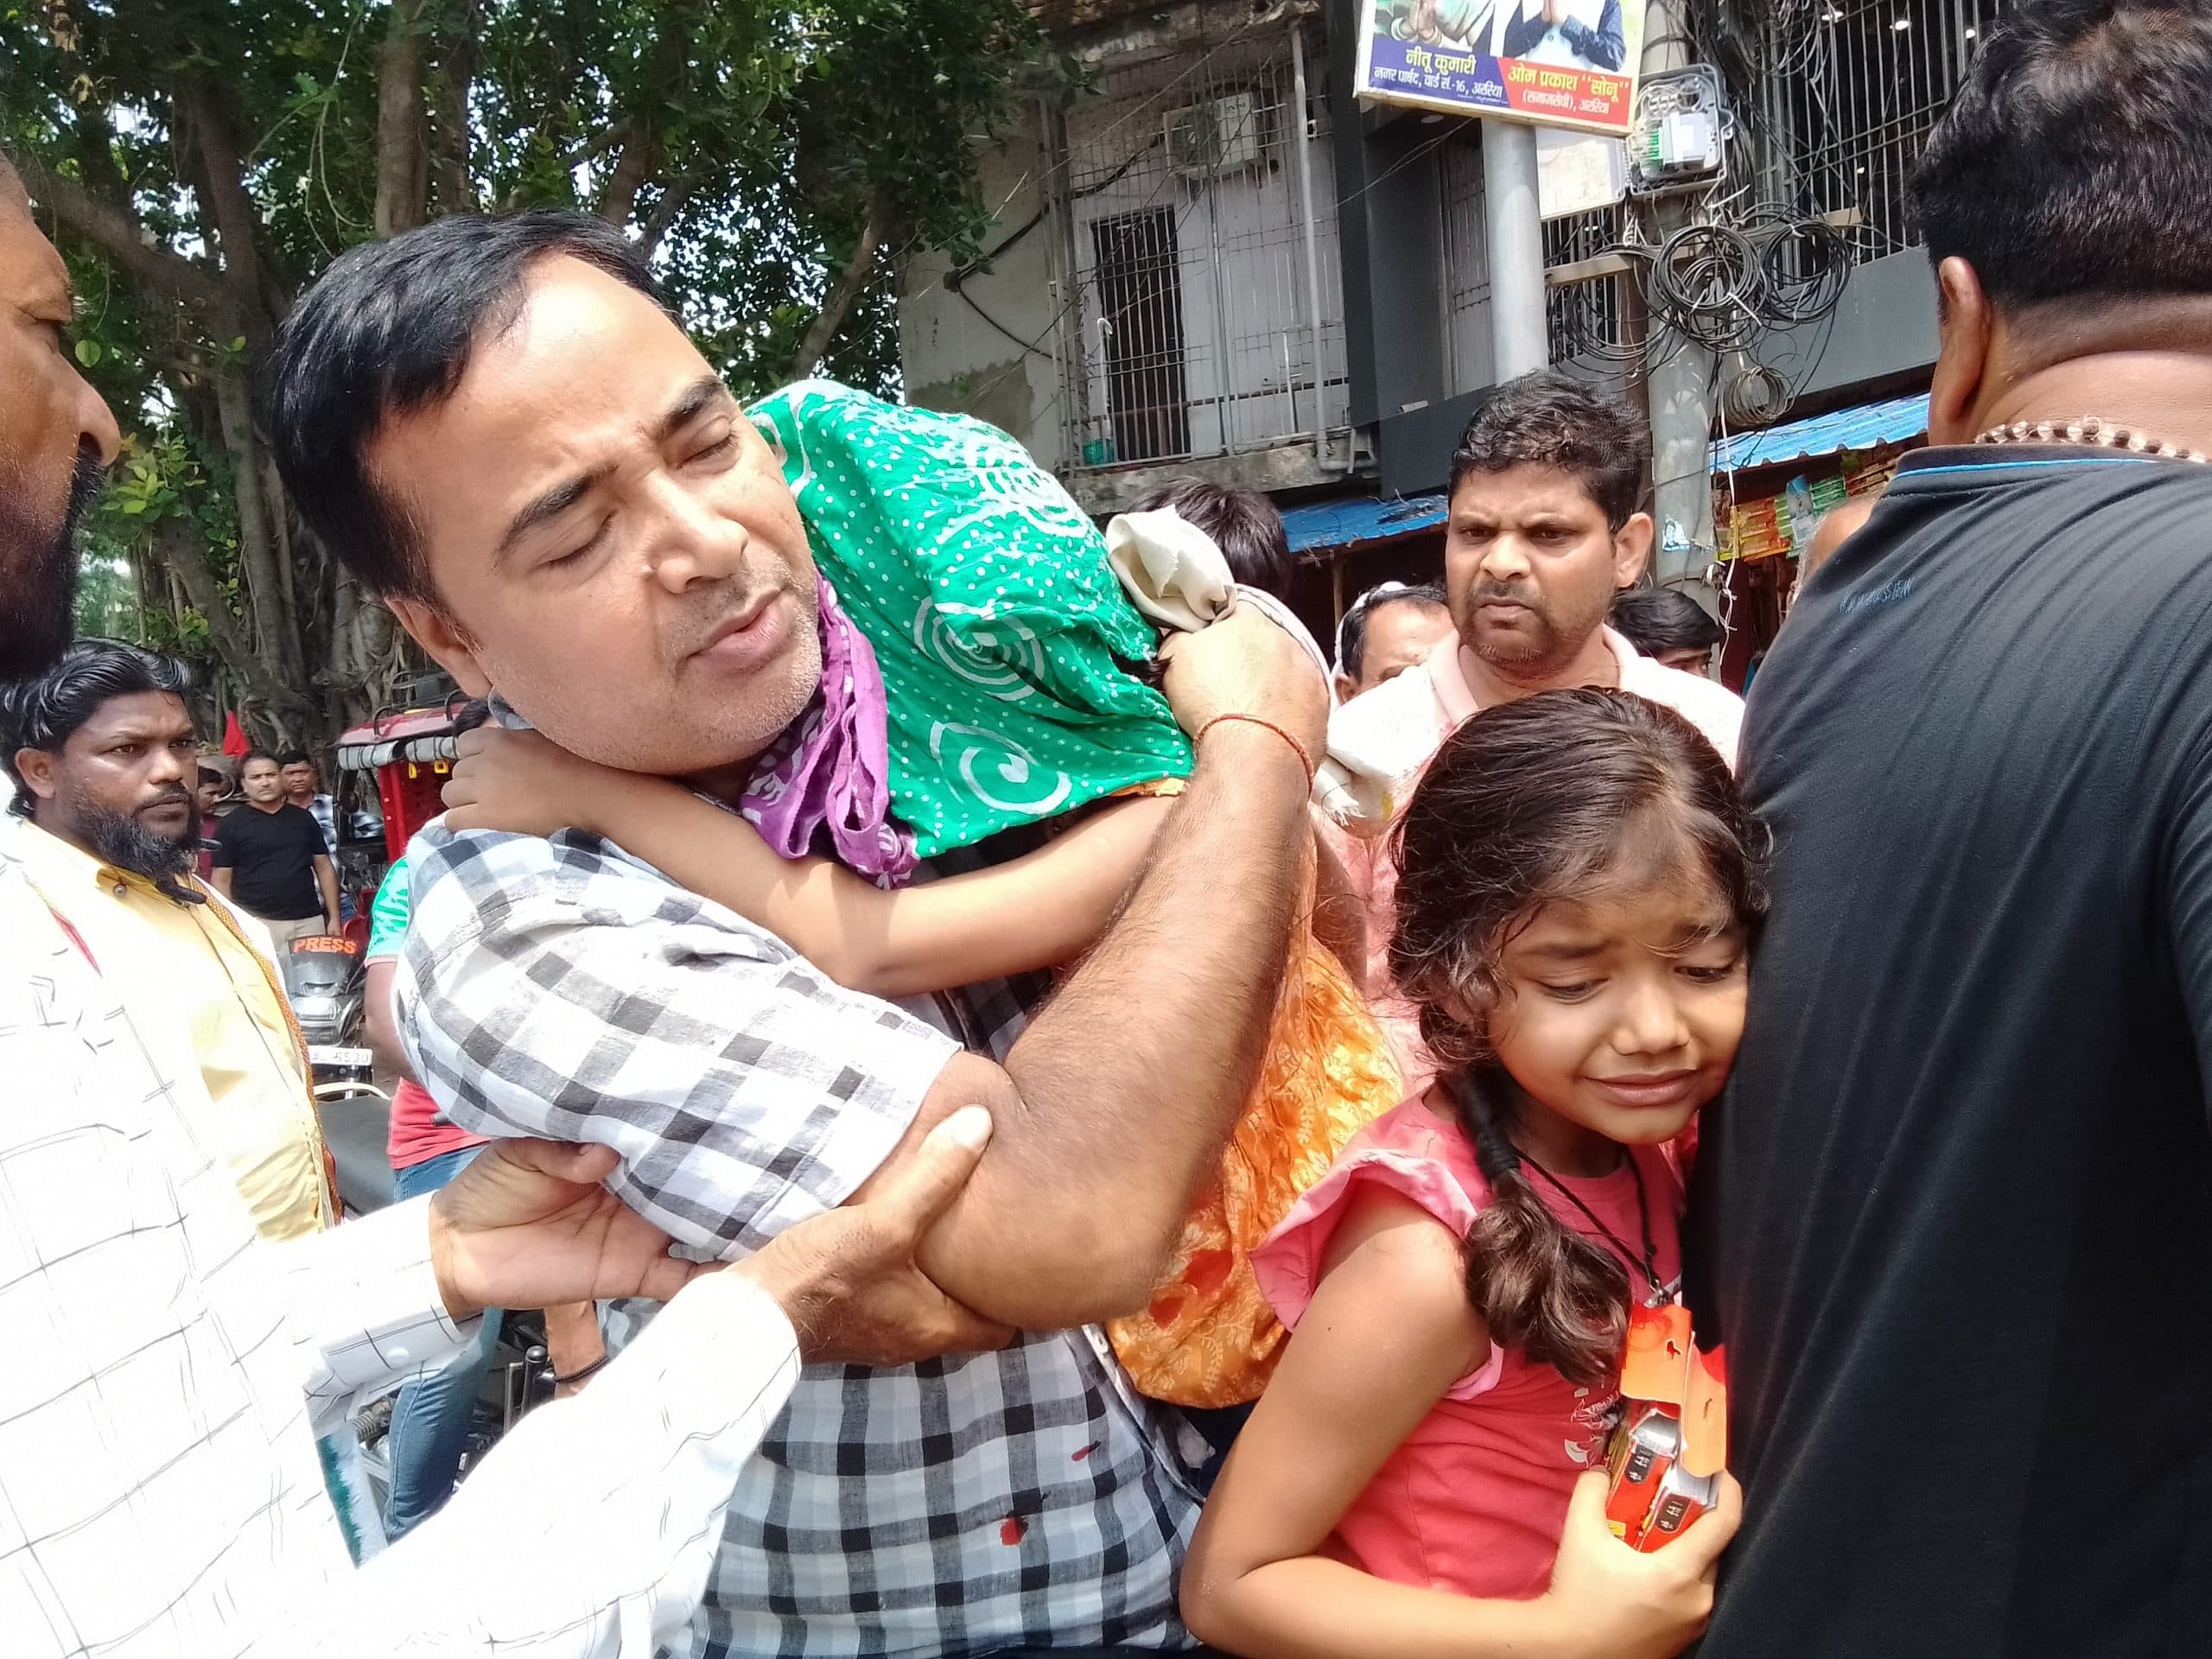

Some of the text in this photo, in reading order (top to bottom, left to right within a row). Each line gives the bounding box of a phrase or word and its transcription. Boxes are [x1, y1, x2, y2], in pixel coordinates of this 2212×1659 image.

[1406, 46, 1477, 76] नीतू कुमारी
[1374, 67, 1397, 81] नगर
[1508, 62, 1537, 85] ओम
[1540, 70, 1578, 91] प्रकाश
[293, 936, 357, 954] PRESS
